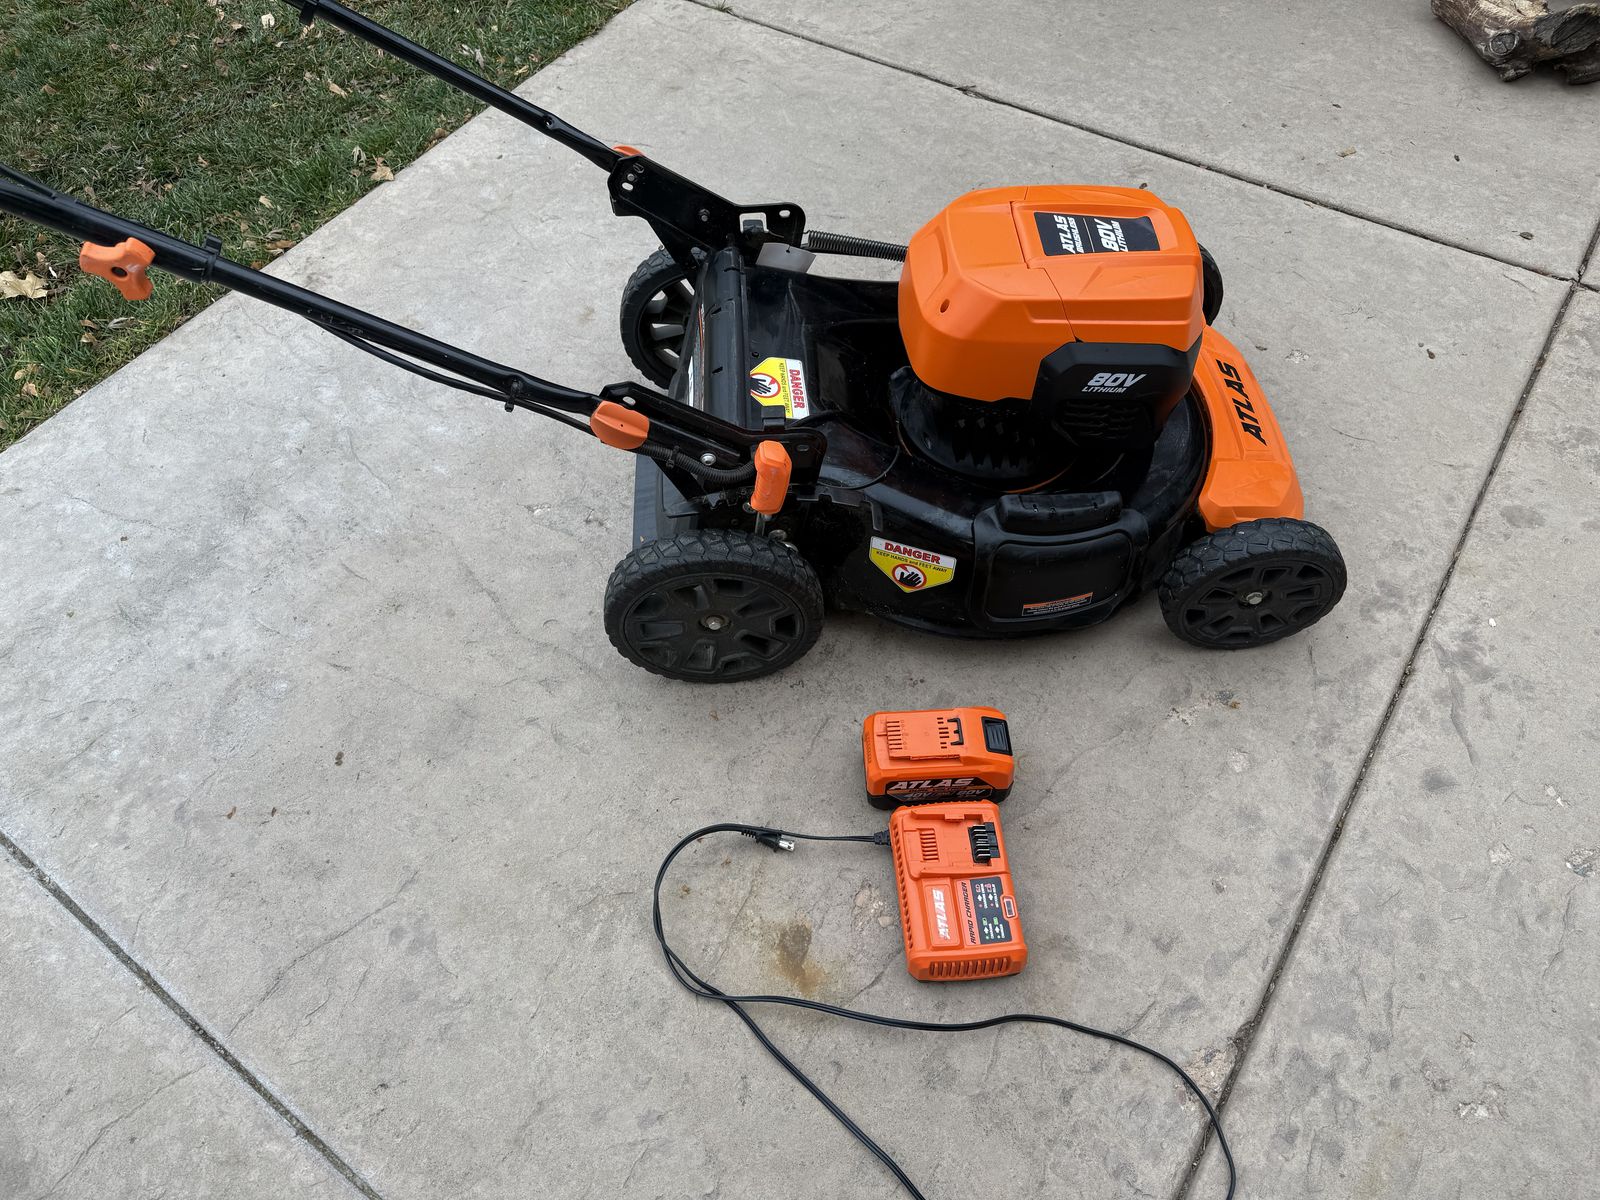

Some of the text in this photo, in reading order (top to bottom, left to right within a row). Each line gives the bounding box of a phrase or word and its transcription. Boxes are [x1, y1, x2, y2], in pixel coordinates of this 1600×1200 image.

[1053, 214, 1076, 254] ATLAS
[1067, 216, 1084, 254] BRUSHLESS
[1094, 218, 1120, 252] 80V
[1111, 220, 1128, 252] LITHIUM
[789, 369, 805, 408] DANGER
[1087, 372, 1148, 387] 80V
[1216, 359, 1267, 446] ATLAS
[884, 541, 941, 564] DANGER
[890, 554, 908, 563] HANDS
[919, 561, 932, 569] FEET
[889, 778, 975, 790] ATLAS
[932, 889, 951, 940] ATLAS
[961, 881, 977, 944] RAPID CHARGER
